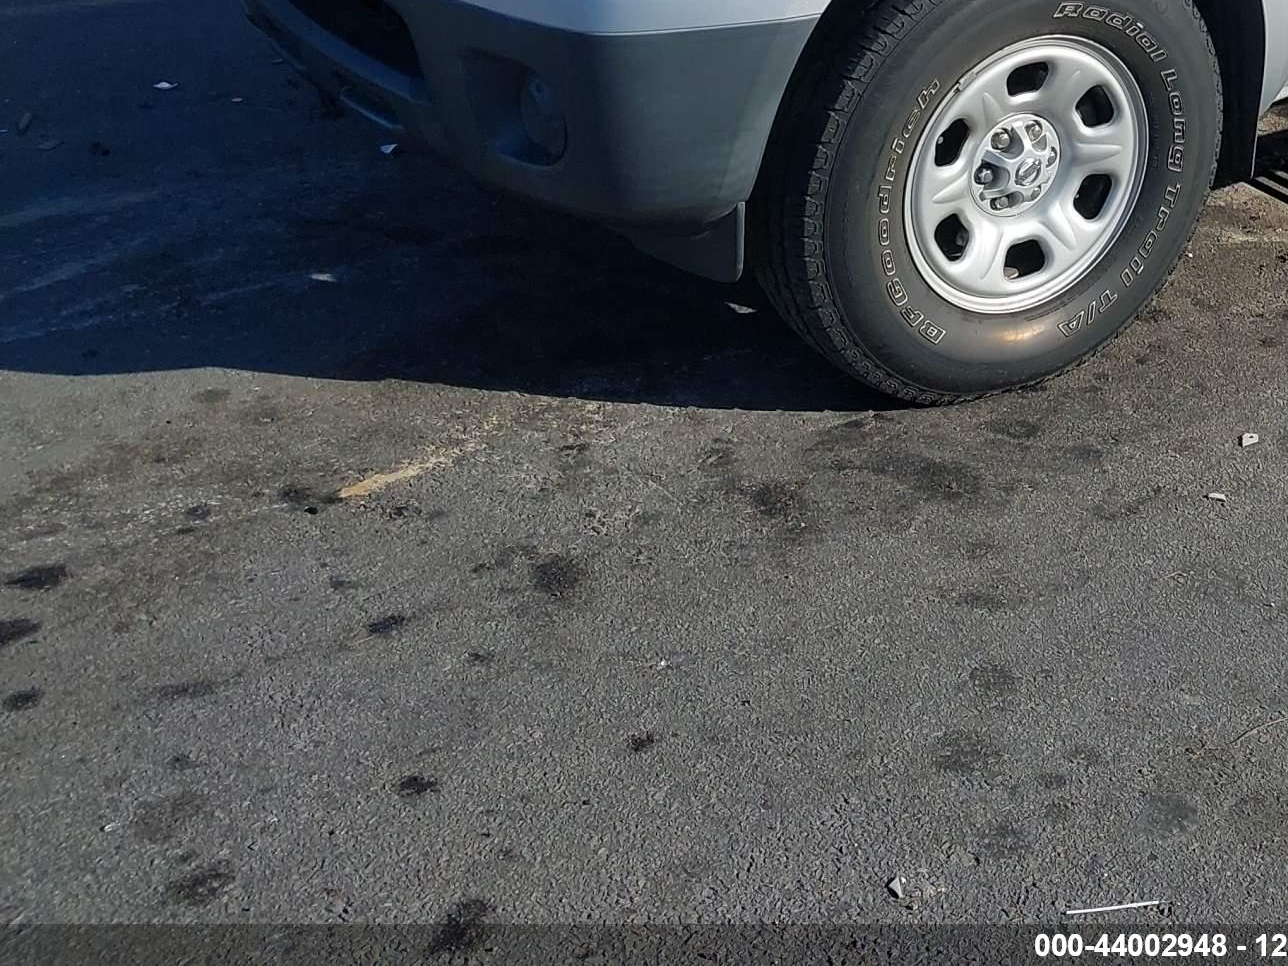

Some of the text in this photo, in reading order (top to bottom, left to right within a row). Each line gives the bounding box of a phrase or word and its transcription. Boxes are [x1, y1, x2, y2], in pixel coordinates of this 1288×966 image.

[879, 78, 946, 345] BFGoodrich
[1053, 1, 1186, 338] Radial Long Trail T/A
